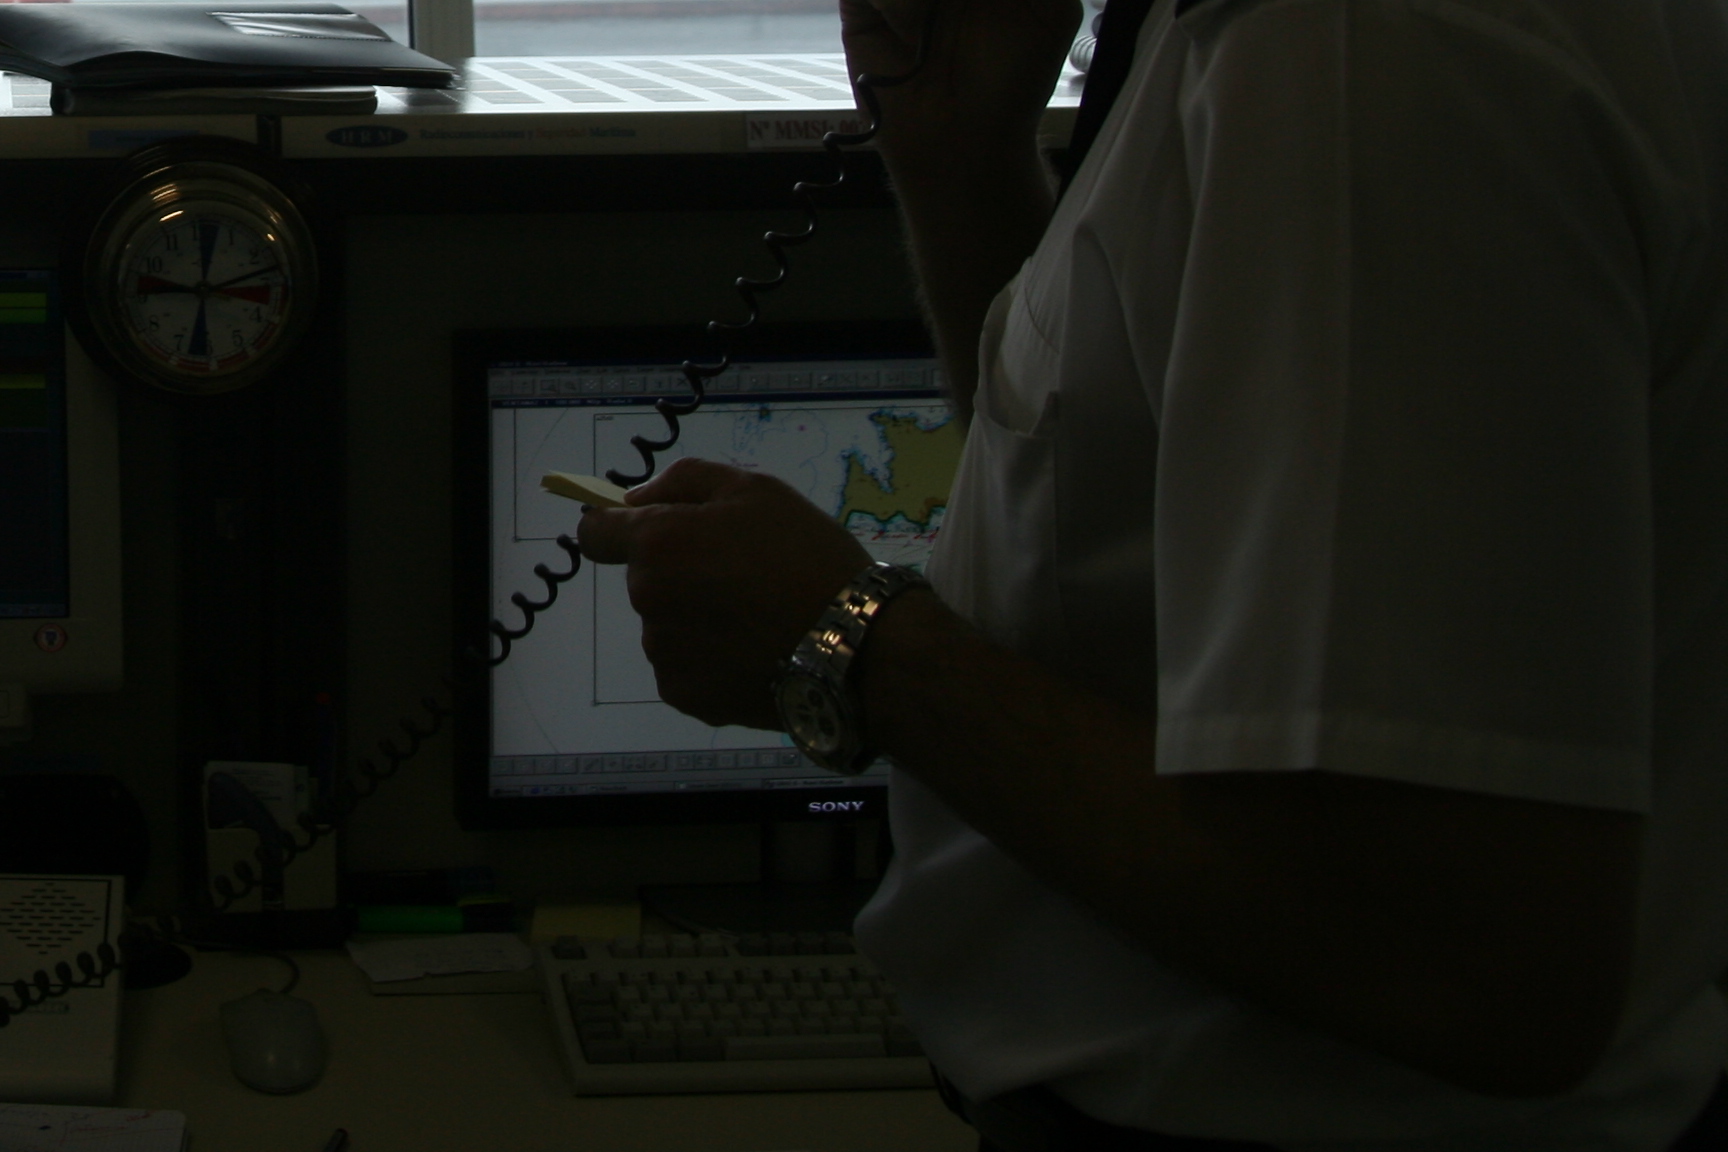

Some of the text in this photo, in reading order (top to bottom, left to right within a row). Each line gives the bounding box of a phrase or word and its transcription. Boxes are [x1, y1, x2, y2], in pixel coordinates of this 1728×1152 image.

[165, 234, 179, 251] 11
[145, 256, 163, 274] 10
[248, 247, 261, 266] 2
[148, 314, 160, 332] 8
[248, 305, 264, 324] 4
[173, 333, 185, 352] 7
[231, 328, 244, 347] 5
[808, 800, 865, 814] SONY
